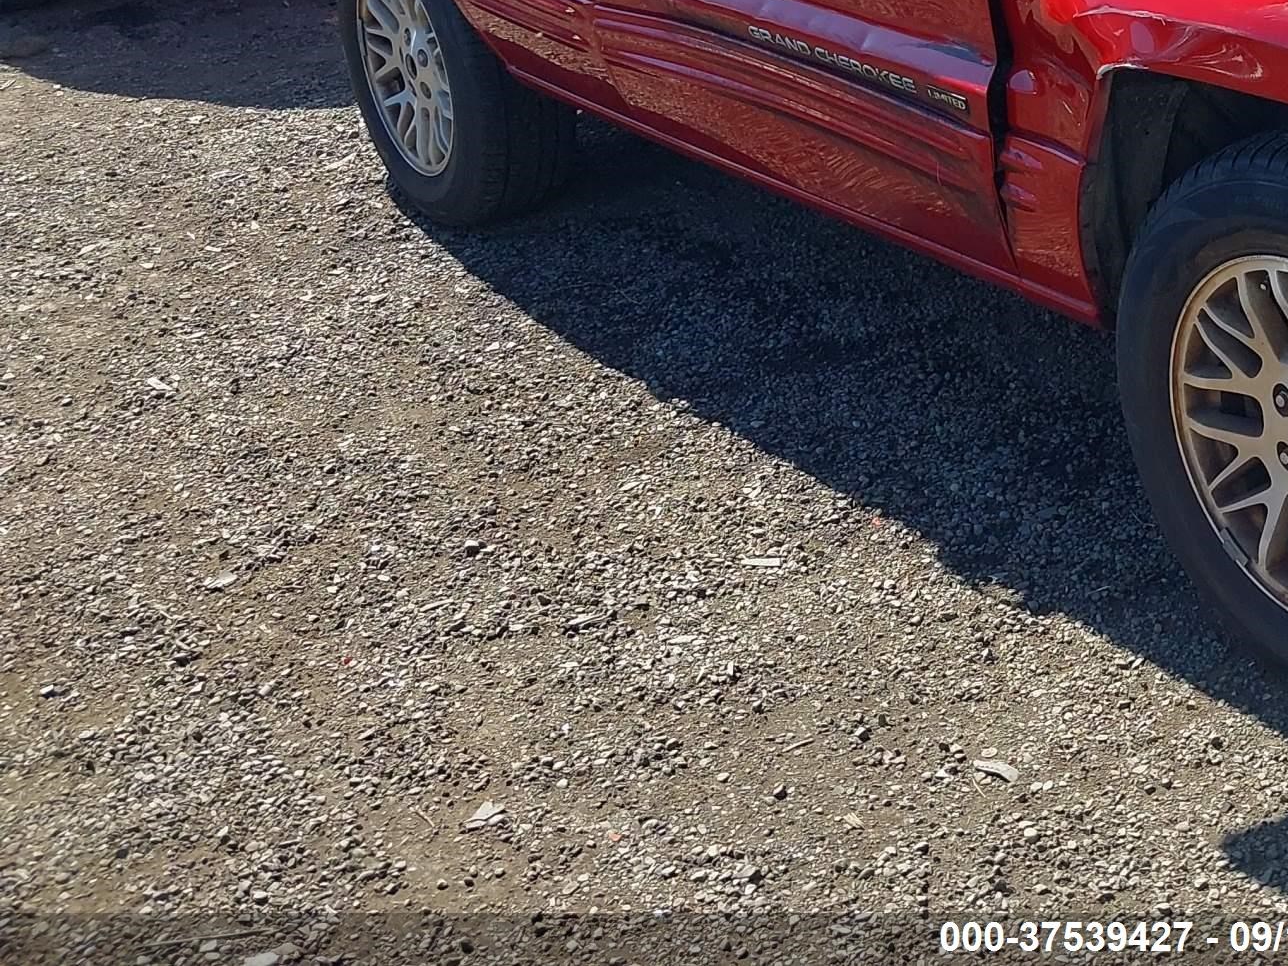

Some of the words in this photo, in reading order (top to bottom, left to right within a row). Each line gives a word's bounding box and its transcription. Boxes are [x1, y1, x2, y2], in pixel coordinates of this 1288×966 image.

[748, 25, 811, 56] GRAND
[814, 47, 917, 94] CHEROKEE
[927, 88, 966, 110] LIMITED
